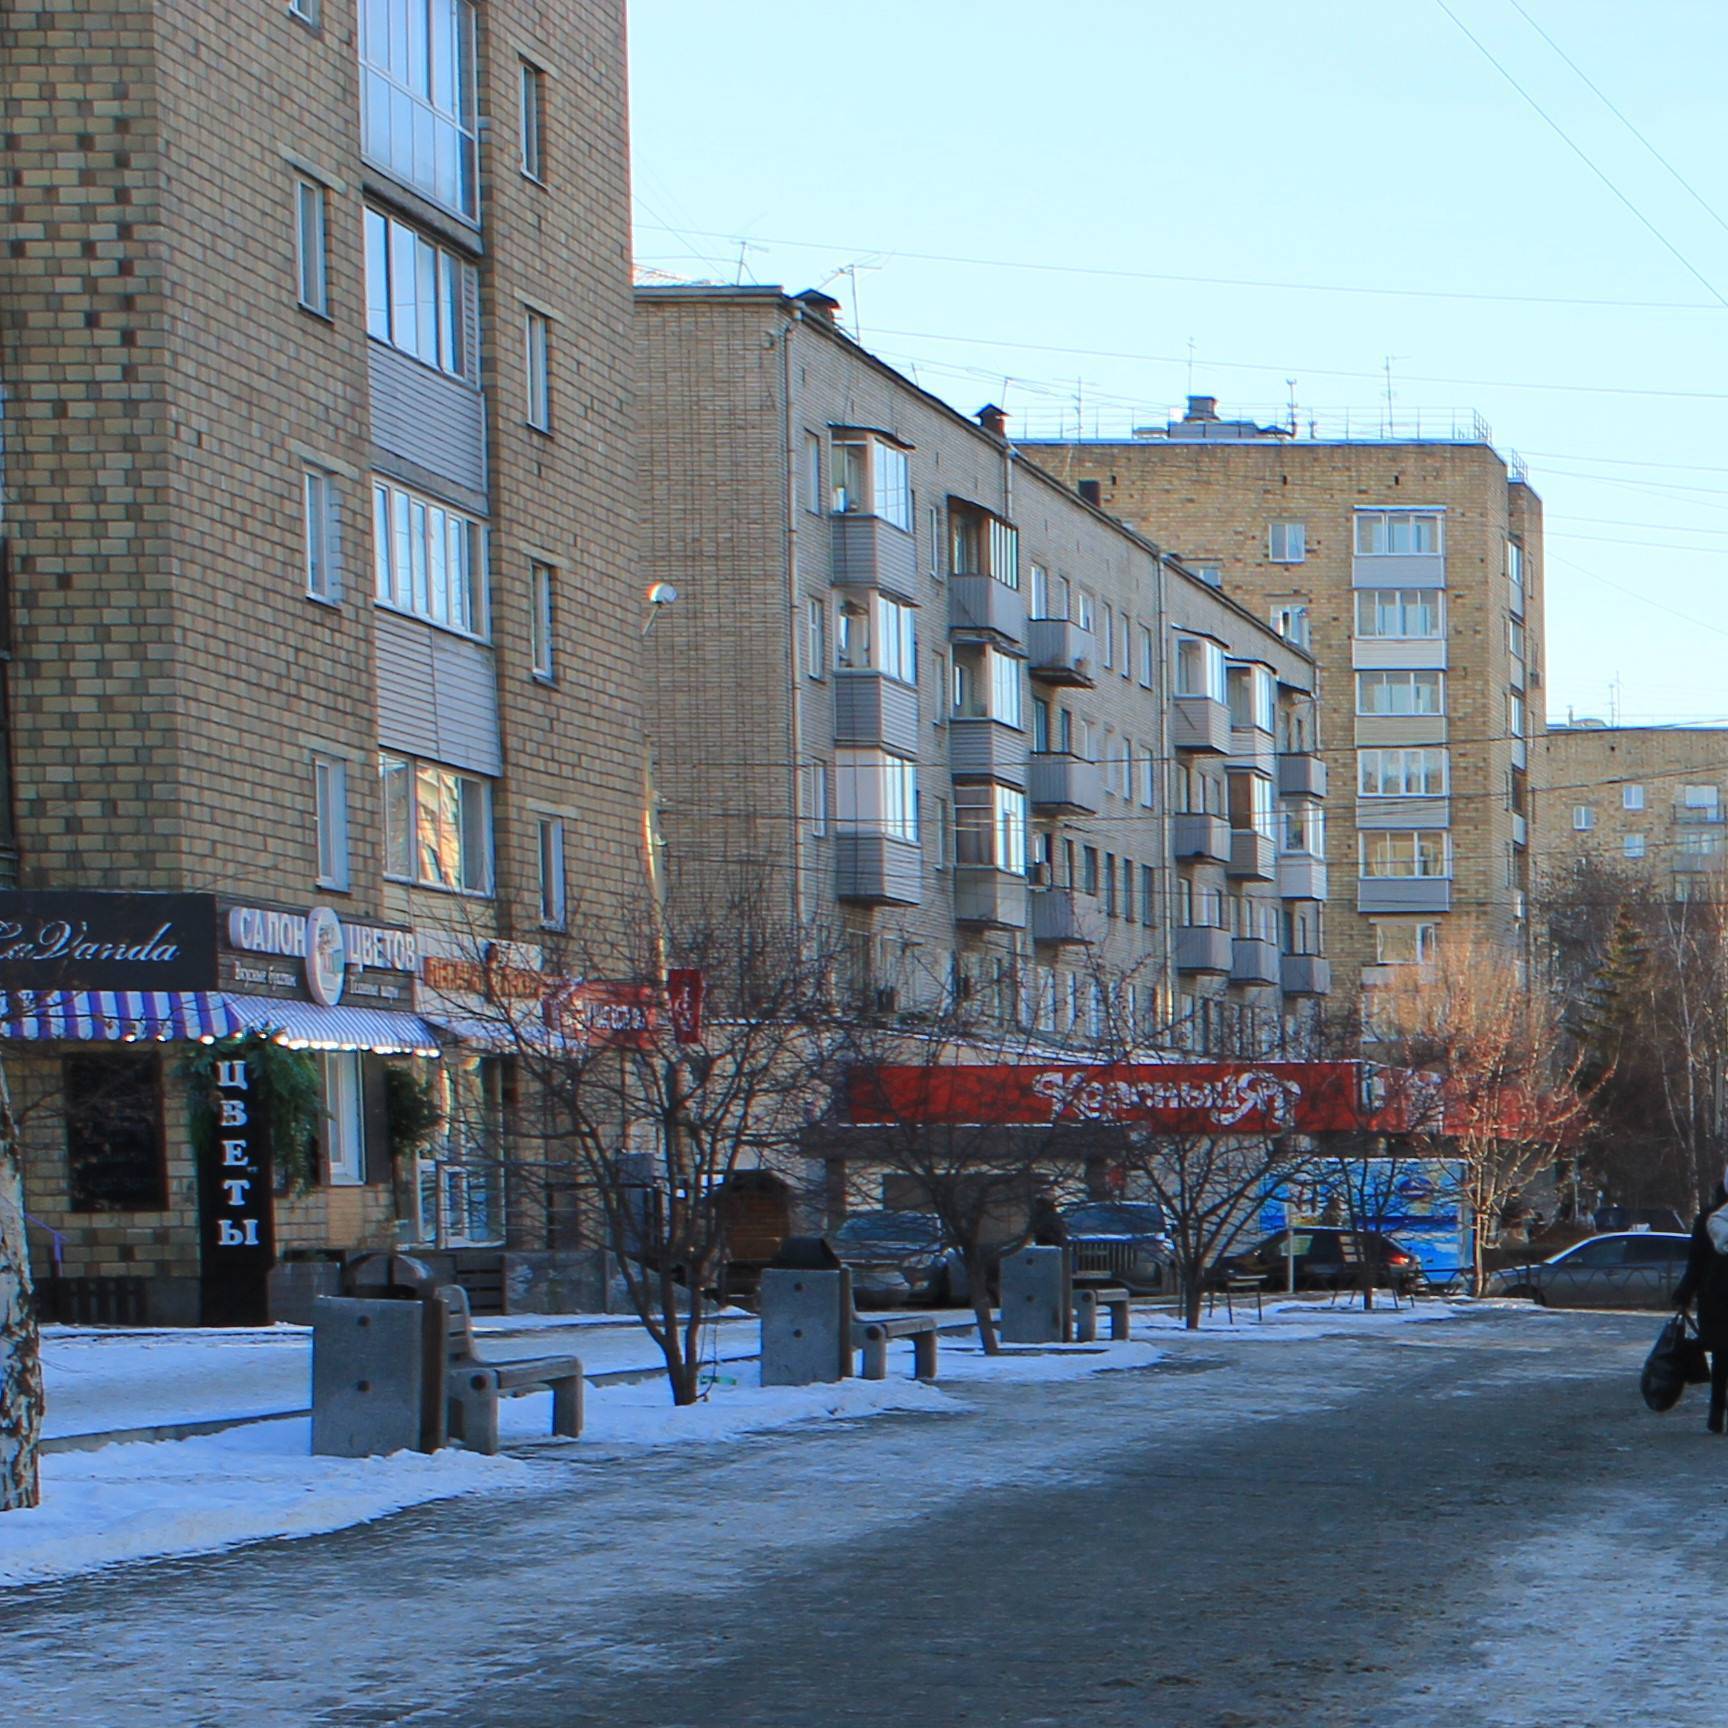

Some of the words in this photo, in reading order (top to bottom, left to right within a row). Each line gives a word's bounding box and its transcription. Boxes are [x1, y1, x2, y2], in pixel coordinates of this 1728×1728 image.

[239, 907, 306, 958] САЛОН
[345, 923, 417, 973] ЦВЕТОВ
[215, 1060, 260, 1246] ЦВЕТЫ
